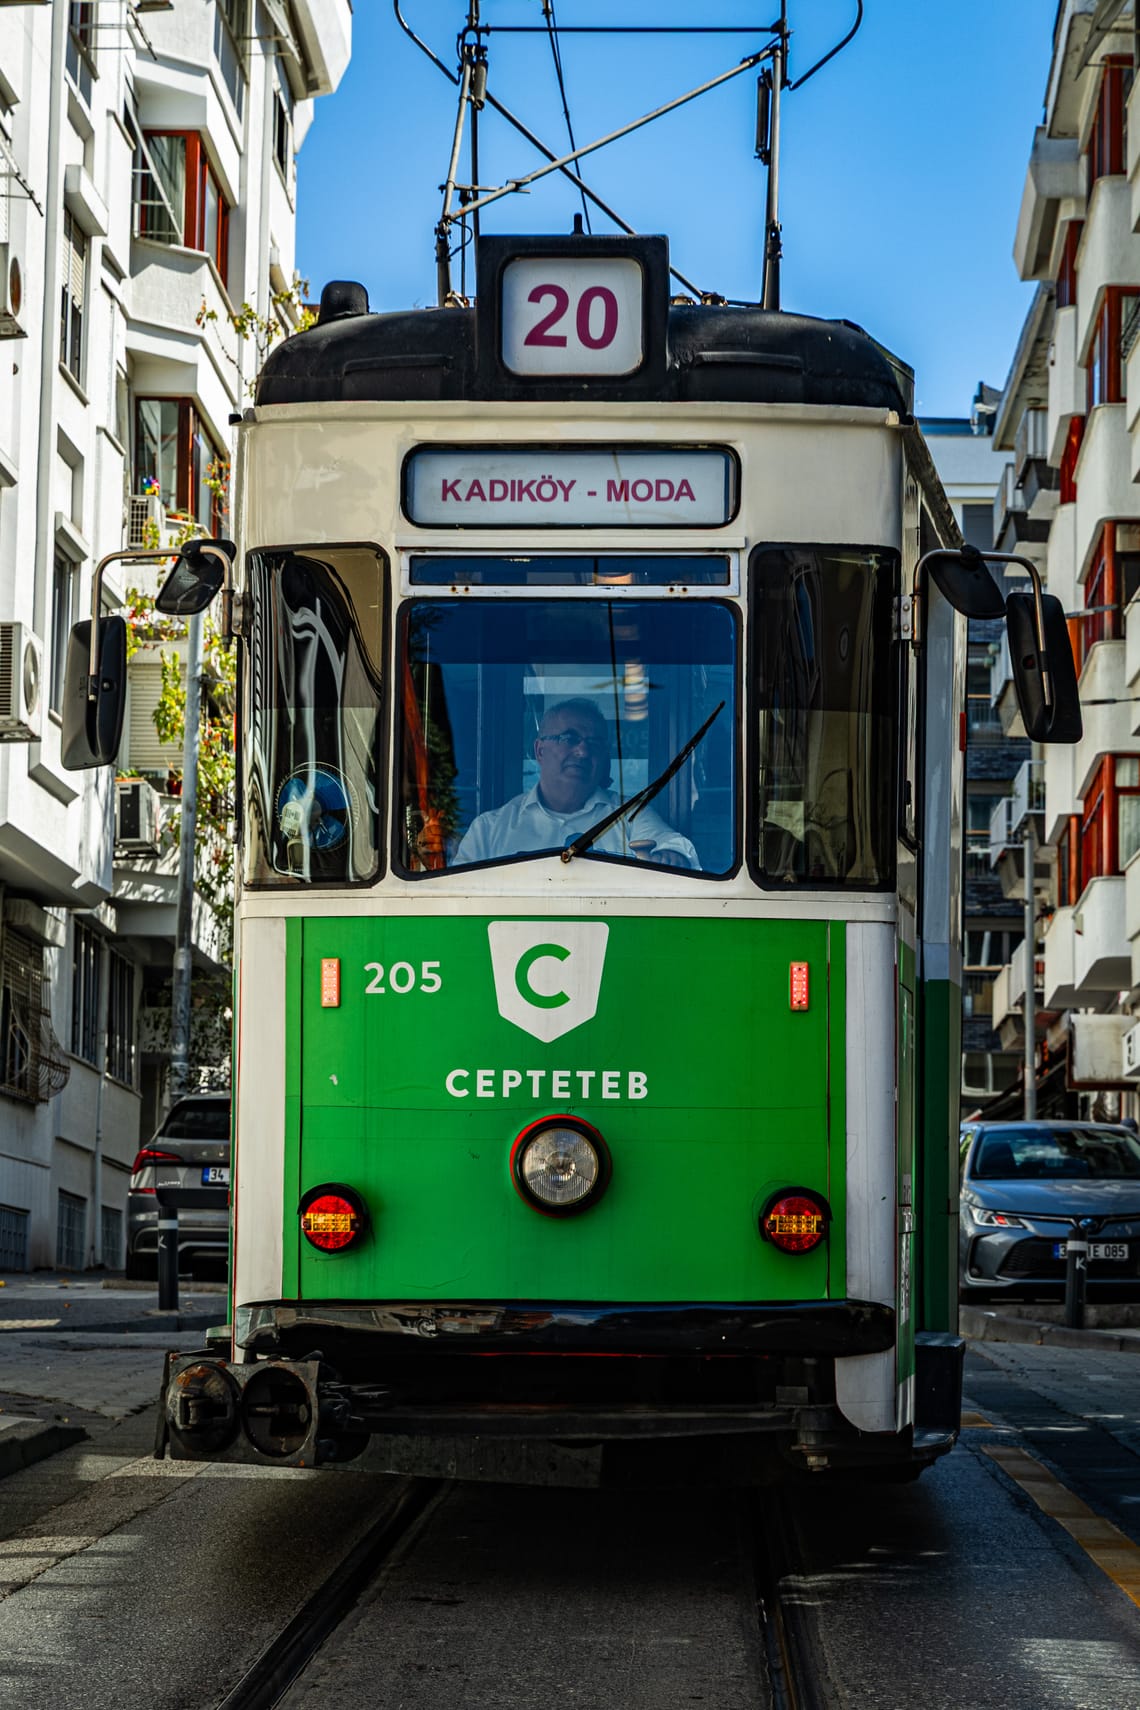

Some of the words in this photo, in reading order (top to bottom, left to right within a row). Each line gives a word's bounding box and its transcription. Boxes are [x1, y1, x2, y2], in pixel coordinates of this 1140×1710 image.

[523, 283, 619, 350] 20
[441, 474, 577, 502] KADIKÖY
[606, 478, 697, 502] MODA
[363, 961, 443, 994] 205
[445, 1069, 649, 1100] CEPTETEB
[210, 1168, 224, 1181] 34
[1104, 1244, 1125, 1257] 085
